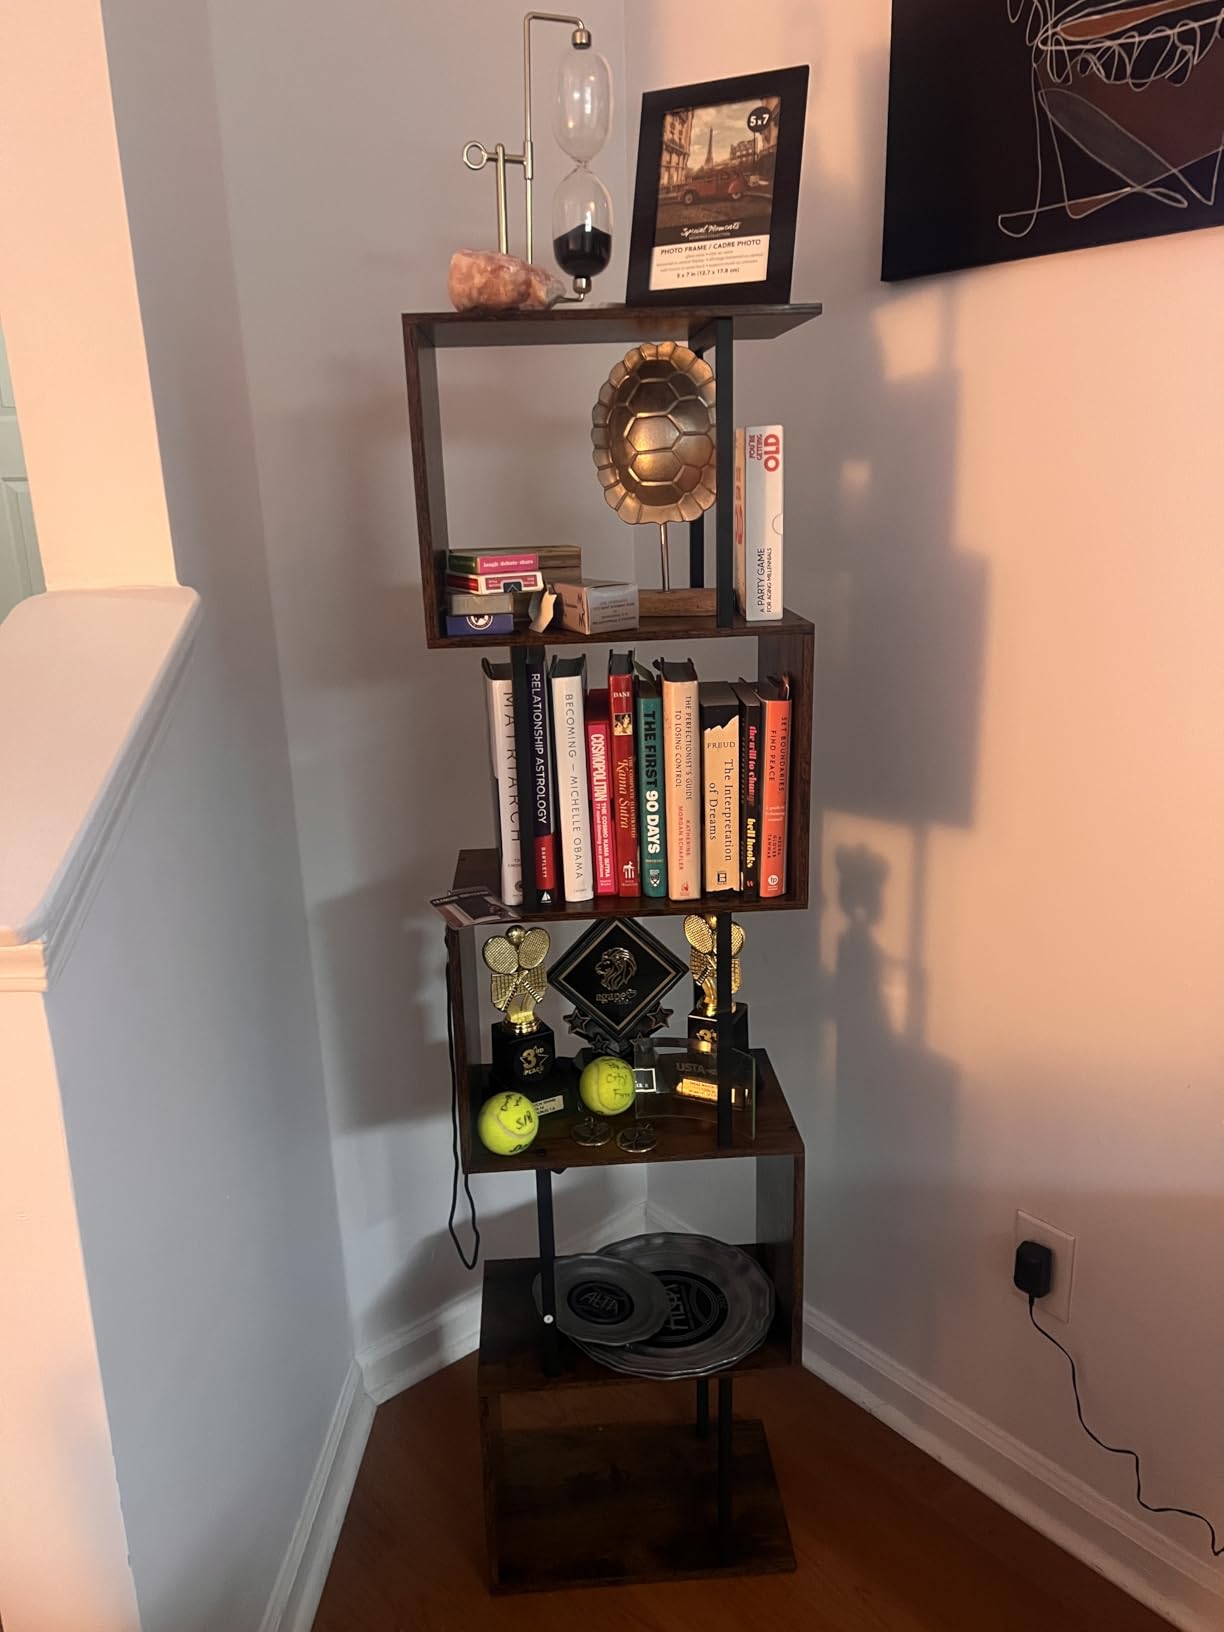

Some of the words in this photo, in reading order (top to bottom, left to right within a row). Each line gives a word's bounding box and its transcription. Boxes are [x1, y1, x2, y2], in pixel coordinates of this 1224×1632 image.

[660, 248, 684, 256] PHOTO
[684, 244, 706, 252] FRAME
[713, 241, 736, 250] CADRE
[764, 433, 780, 472] OLD
[757, 548, 765, 574] GAME
[757, 574, 765, 607] PARTY
[531, 673, 544, 756] RELATIONSHIP
[565, 694, 577, 758] BECOMING
[643, 710, 656, 736] THE
[676, 710, 682, 720] TO
[707, 741, 736, 750] FREUD
[748, 726, 757, 741] the
[644, 739, 658, 788] FIRST
[748, 742, 757, 760] will
[748, 760, 756, 770] to
[590, 734, 608, 802] COSMOPOLITAN
[616, 759, 628, 795] Kama
[724, 759, 734, 781] The
[536, 757, 547, 824] ASTROLOGY
[570, 775, 582, 832] MICHELLE
[646, 790, 659, 812] 90
[710, 782, 718, 796] of
[618, 797, 630, 829] Sutra
[709, 798, 718, 841] Dreams
[722, 784, 734, 862] Interpretation
[747, 818, 756, 838] bell
[647, 814, 660, 854] DAYS
[574, 838, 584, 880] OBAMA
[746, 838, 756, 869] hooks
[676, 1062, 706, 1074] USTA
